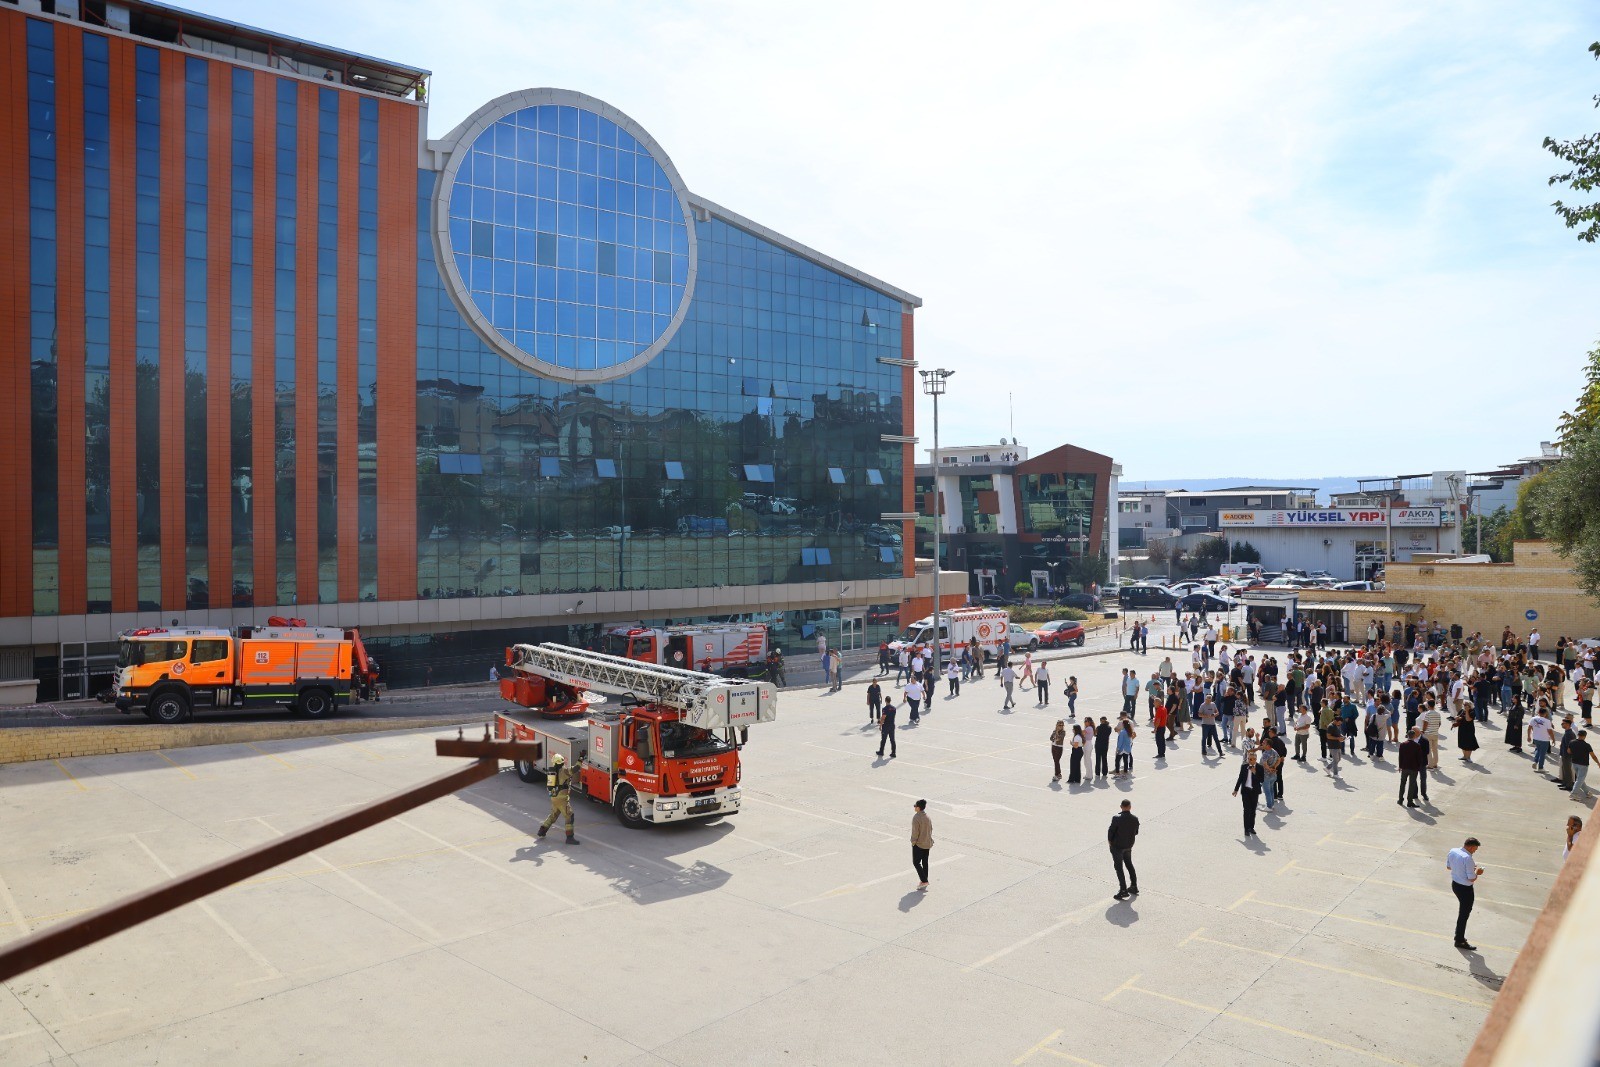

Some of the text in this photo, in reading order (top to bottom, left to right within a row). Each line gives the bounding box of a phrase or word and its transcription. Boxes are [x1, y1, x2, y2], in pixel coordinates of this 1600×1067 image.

[1287, 510, 1346, 522] YÜKSEL
[1407, 510, 1435, 518] AKPA
[692, 773, 718, 784] IVECO
